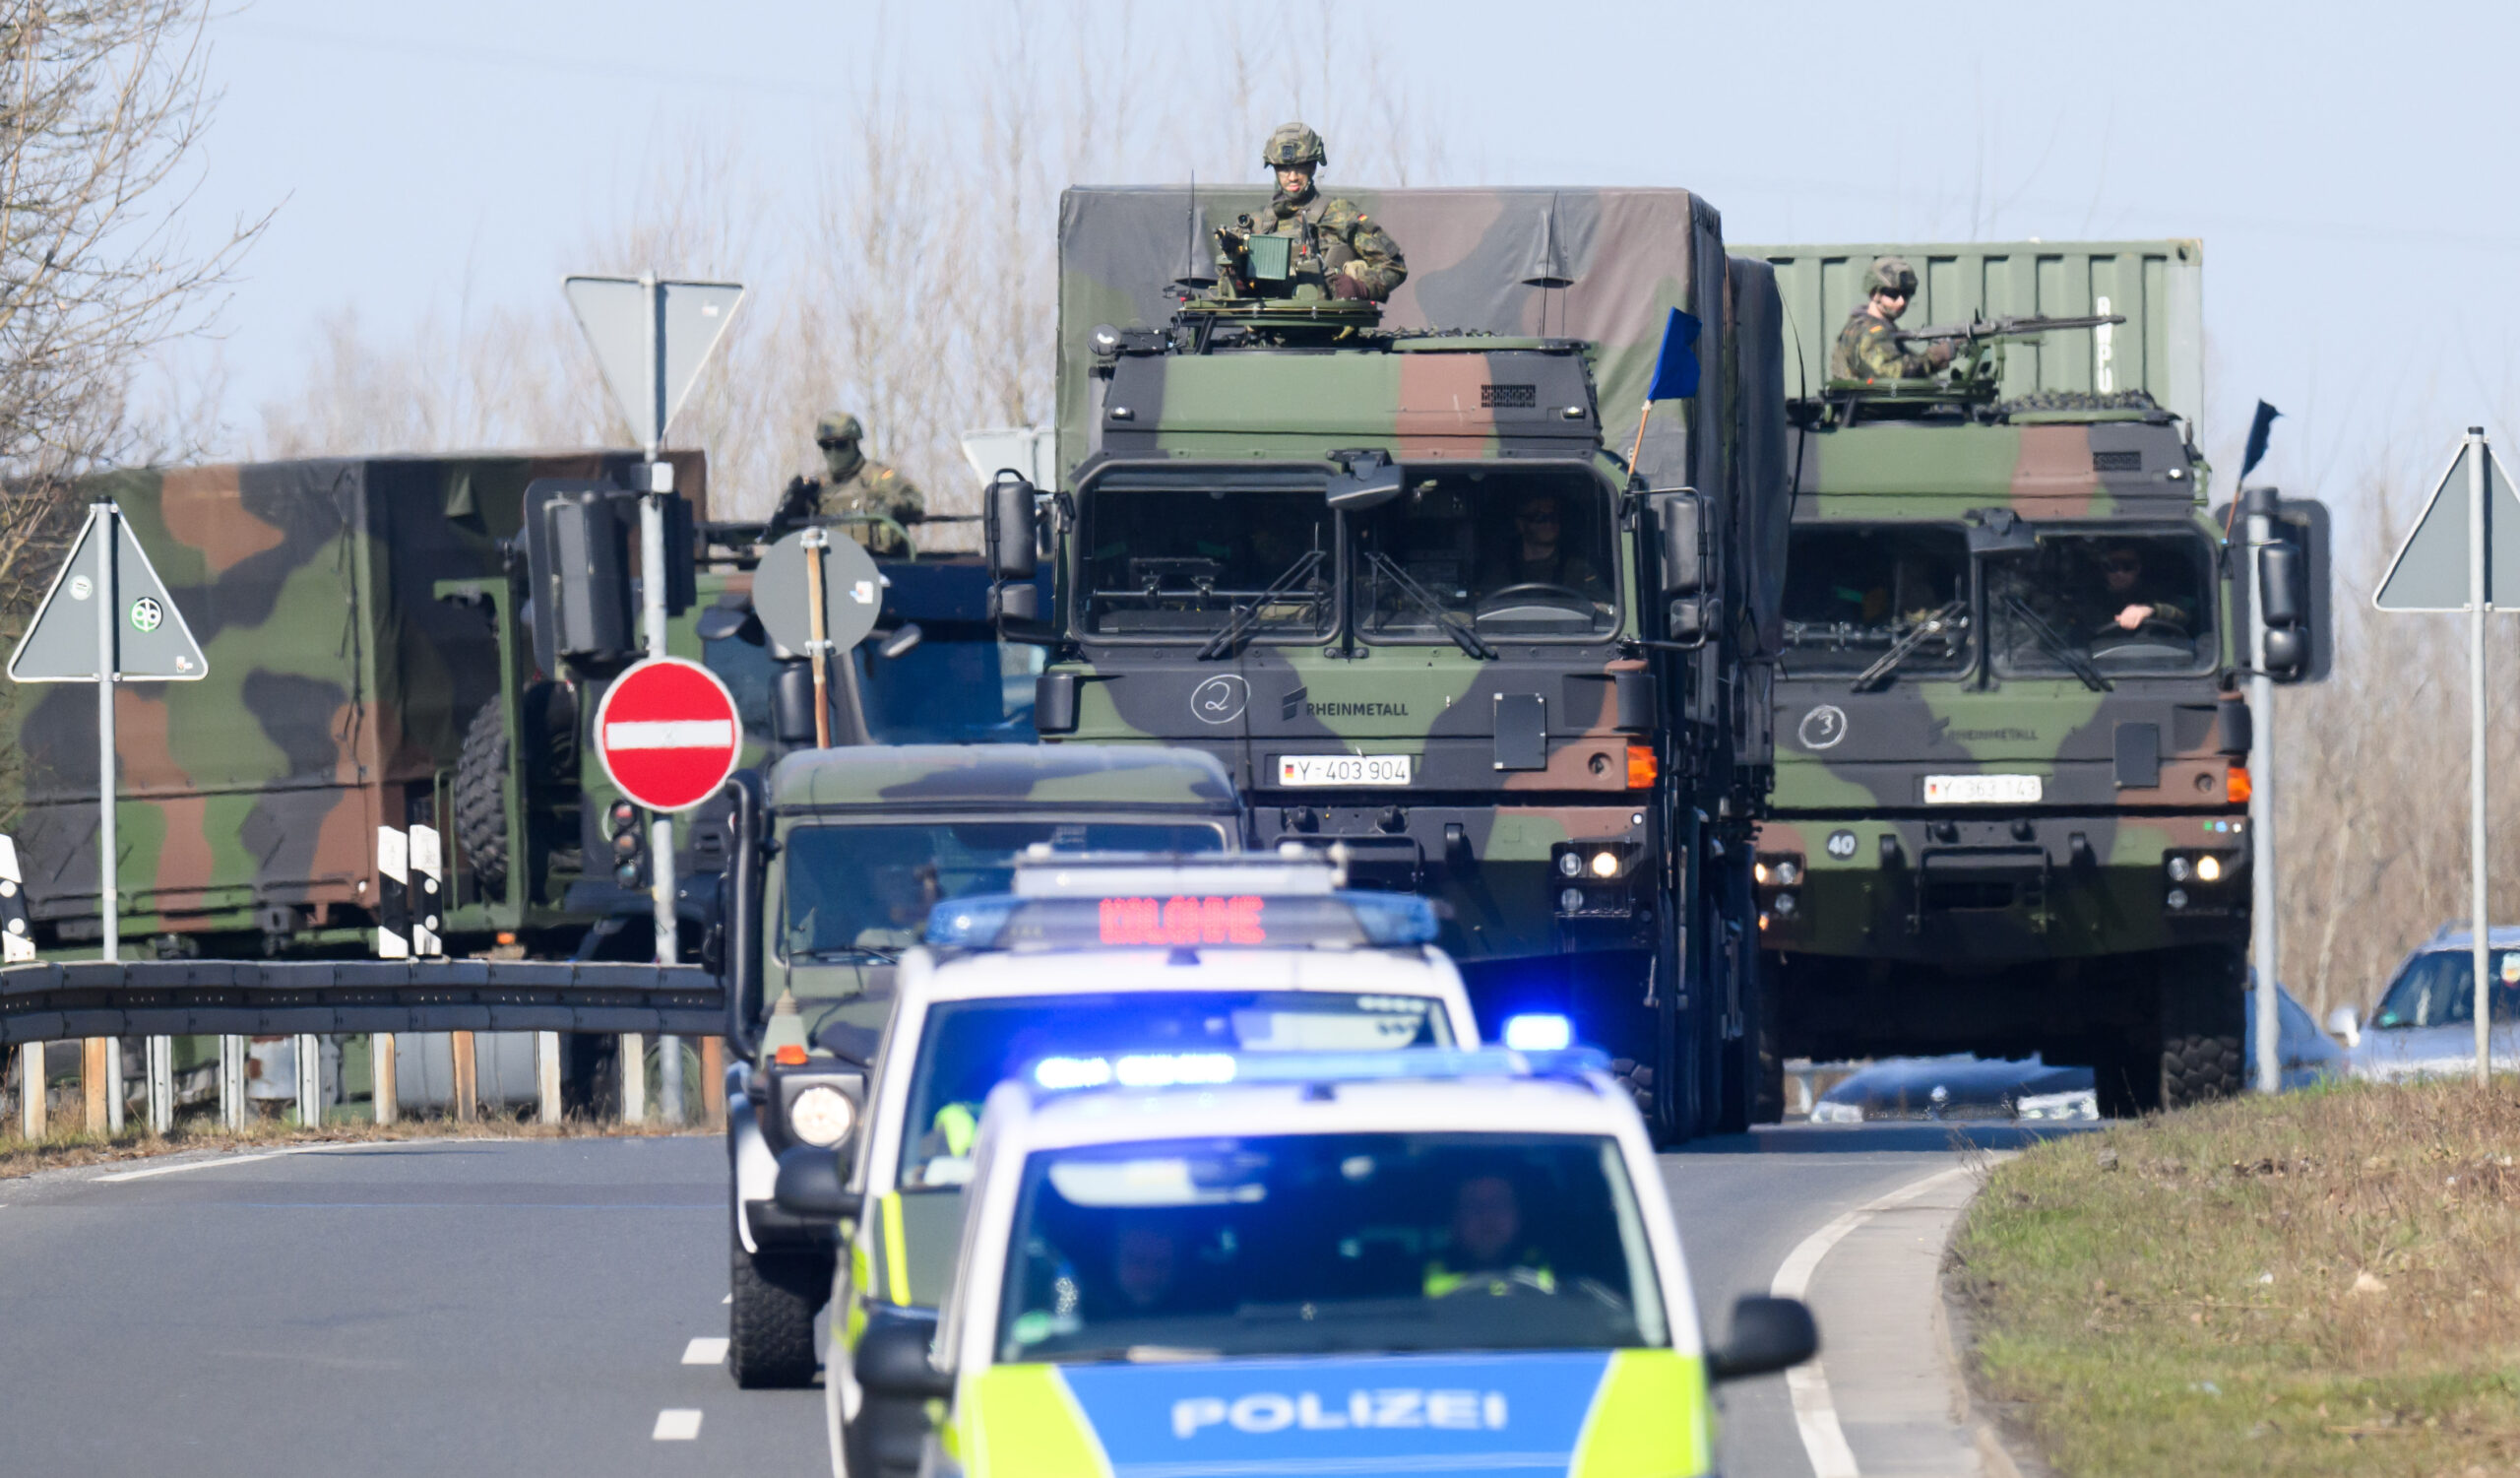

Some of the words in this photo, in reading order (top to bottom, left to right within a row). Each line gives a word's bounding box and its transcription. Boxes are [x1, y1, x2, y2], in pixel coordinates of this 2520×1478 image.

[1205, 681, 1228, 711] 2
[1307, 703, 1409, 717] RHEINMETALL
[1819, 713, 1833, 735] 3
[1828, 835, 1856, 855] 40
[1172, 1389, 1507, 1439] POLIZEI
